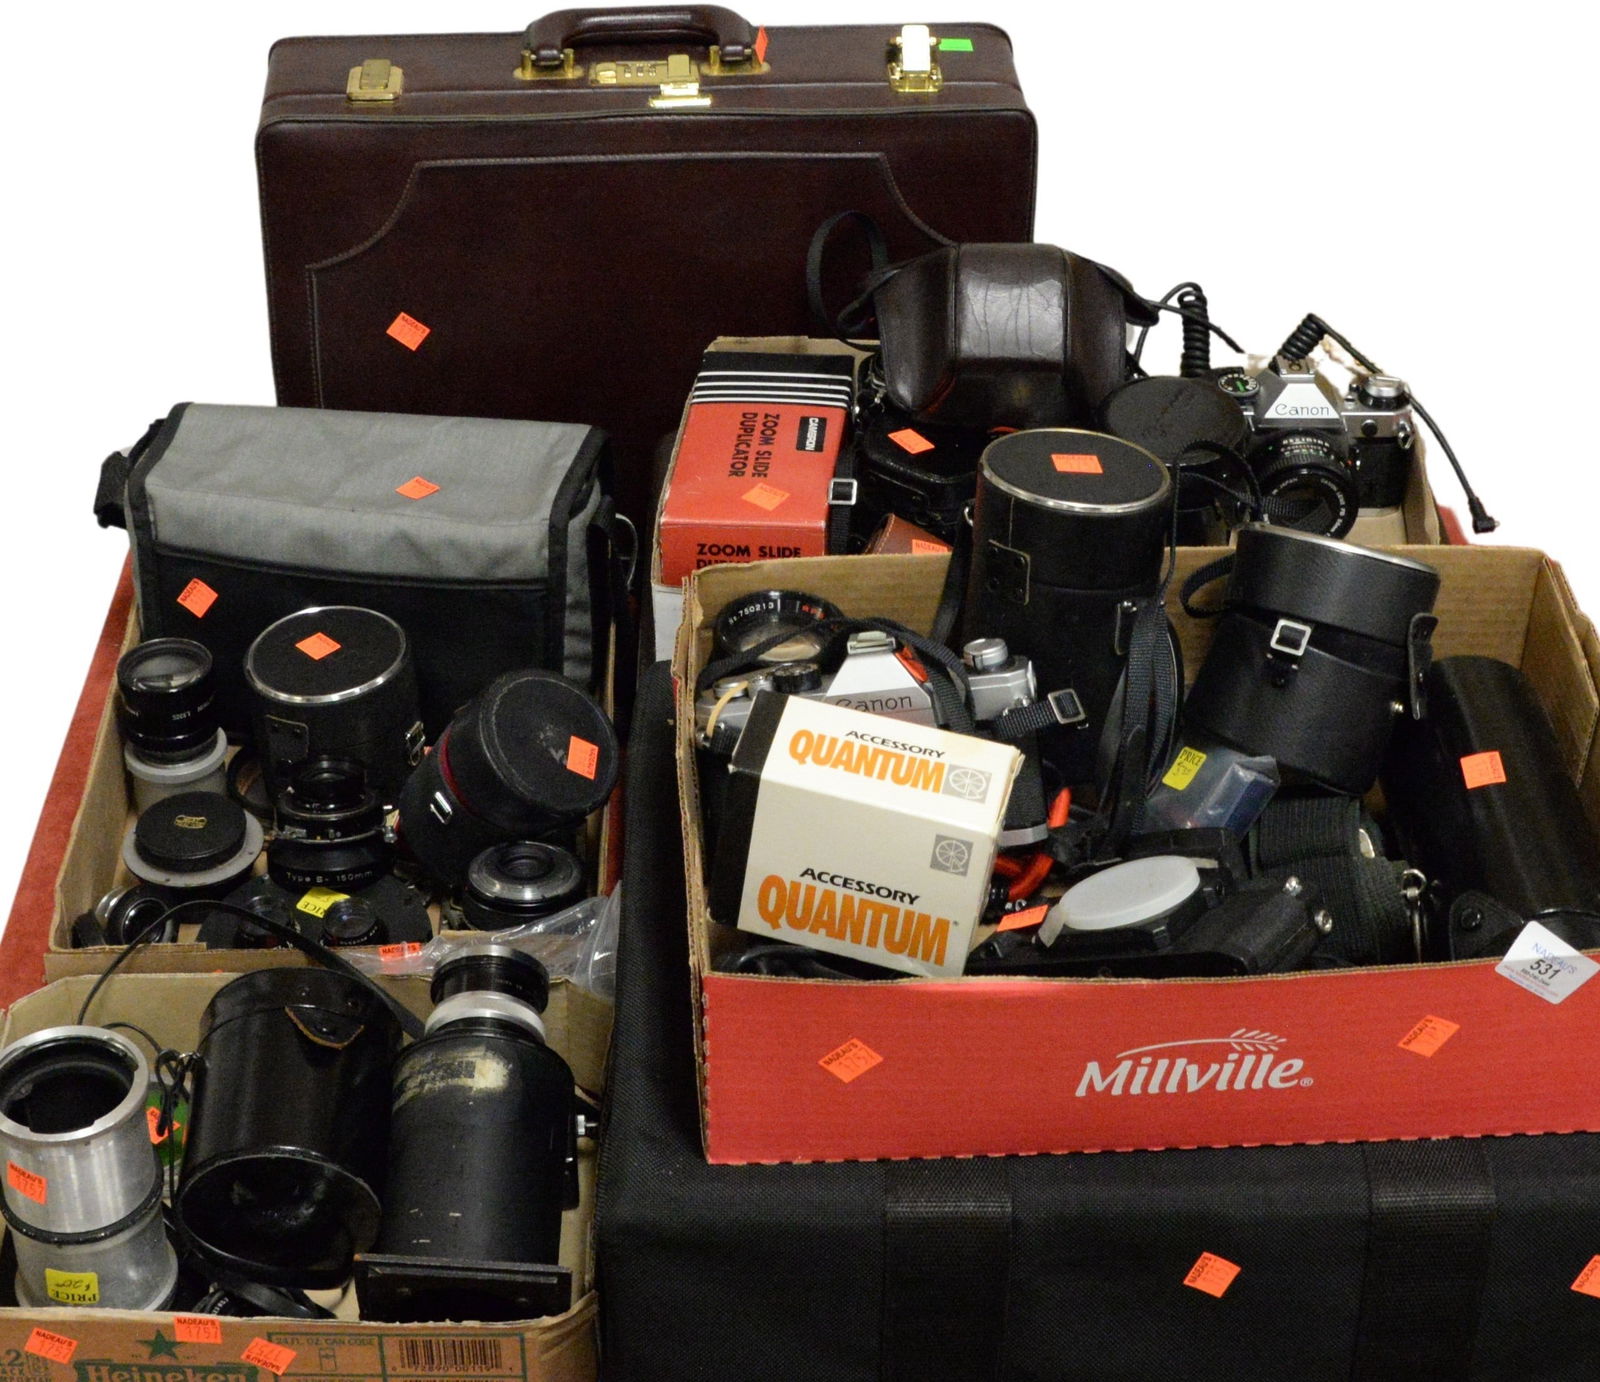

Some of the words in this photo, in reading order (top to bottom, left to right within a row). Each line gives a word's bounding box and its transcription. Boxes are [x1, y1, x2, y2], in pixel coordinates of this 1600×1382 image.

[1274, 403, 1331, 417] Canon
[758, 413, 780, 446] ZOOM
[728, 412, 758, 478] DUPLICATOR
[752, 450, 773, 478] SLIDE
[696, 543, 751, 558] ZOOM
[758, 545, 803, 558] SLIDE
[738, 601, 775, 619] 750213
[845, 730, 945, 759] ACCESSORY
[788, 729, 946, 795] QUANTUM
[1180, 750, 1204, 766] PRICE
[336, 869, 374, 882] 150mm
[799, 867, 921, 906] ACCESSORY
[757, 874, 951, 968] QUANTUM
[1529, 958, 1562, 981] 531
[1074, 1053, 1304, 1097] Millville
[51, 1289, 97, 1302] PRICE
[0, 1348, 25, 1367] 2
[86, 1364, 248, 1382] Heineken
